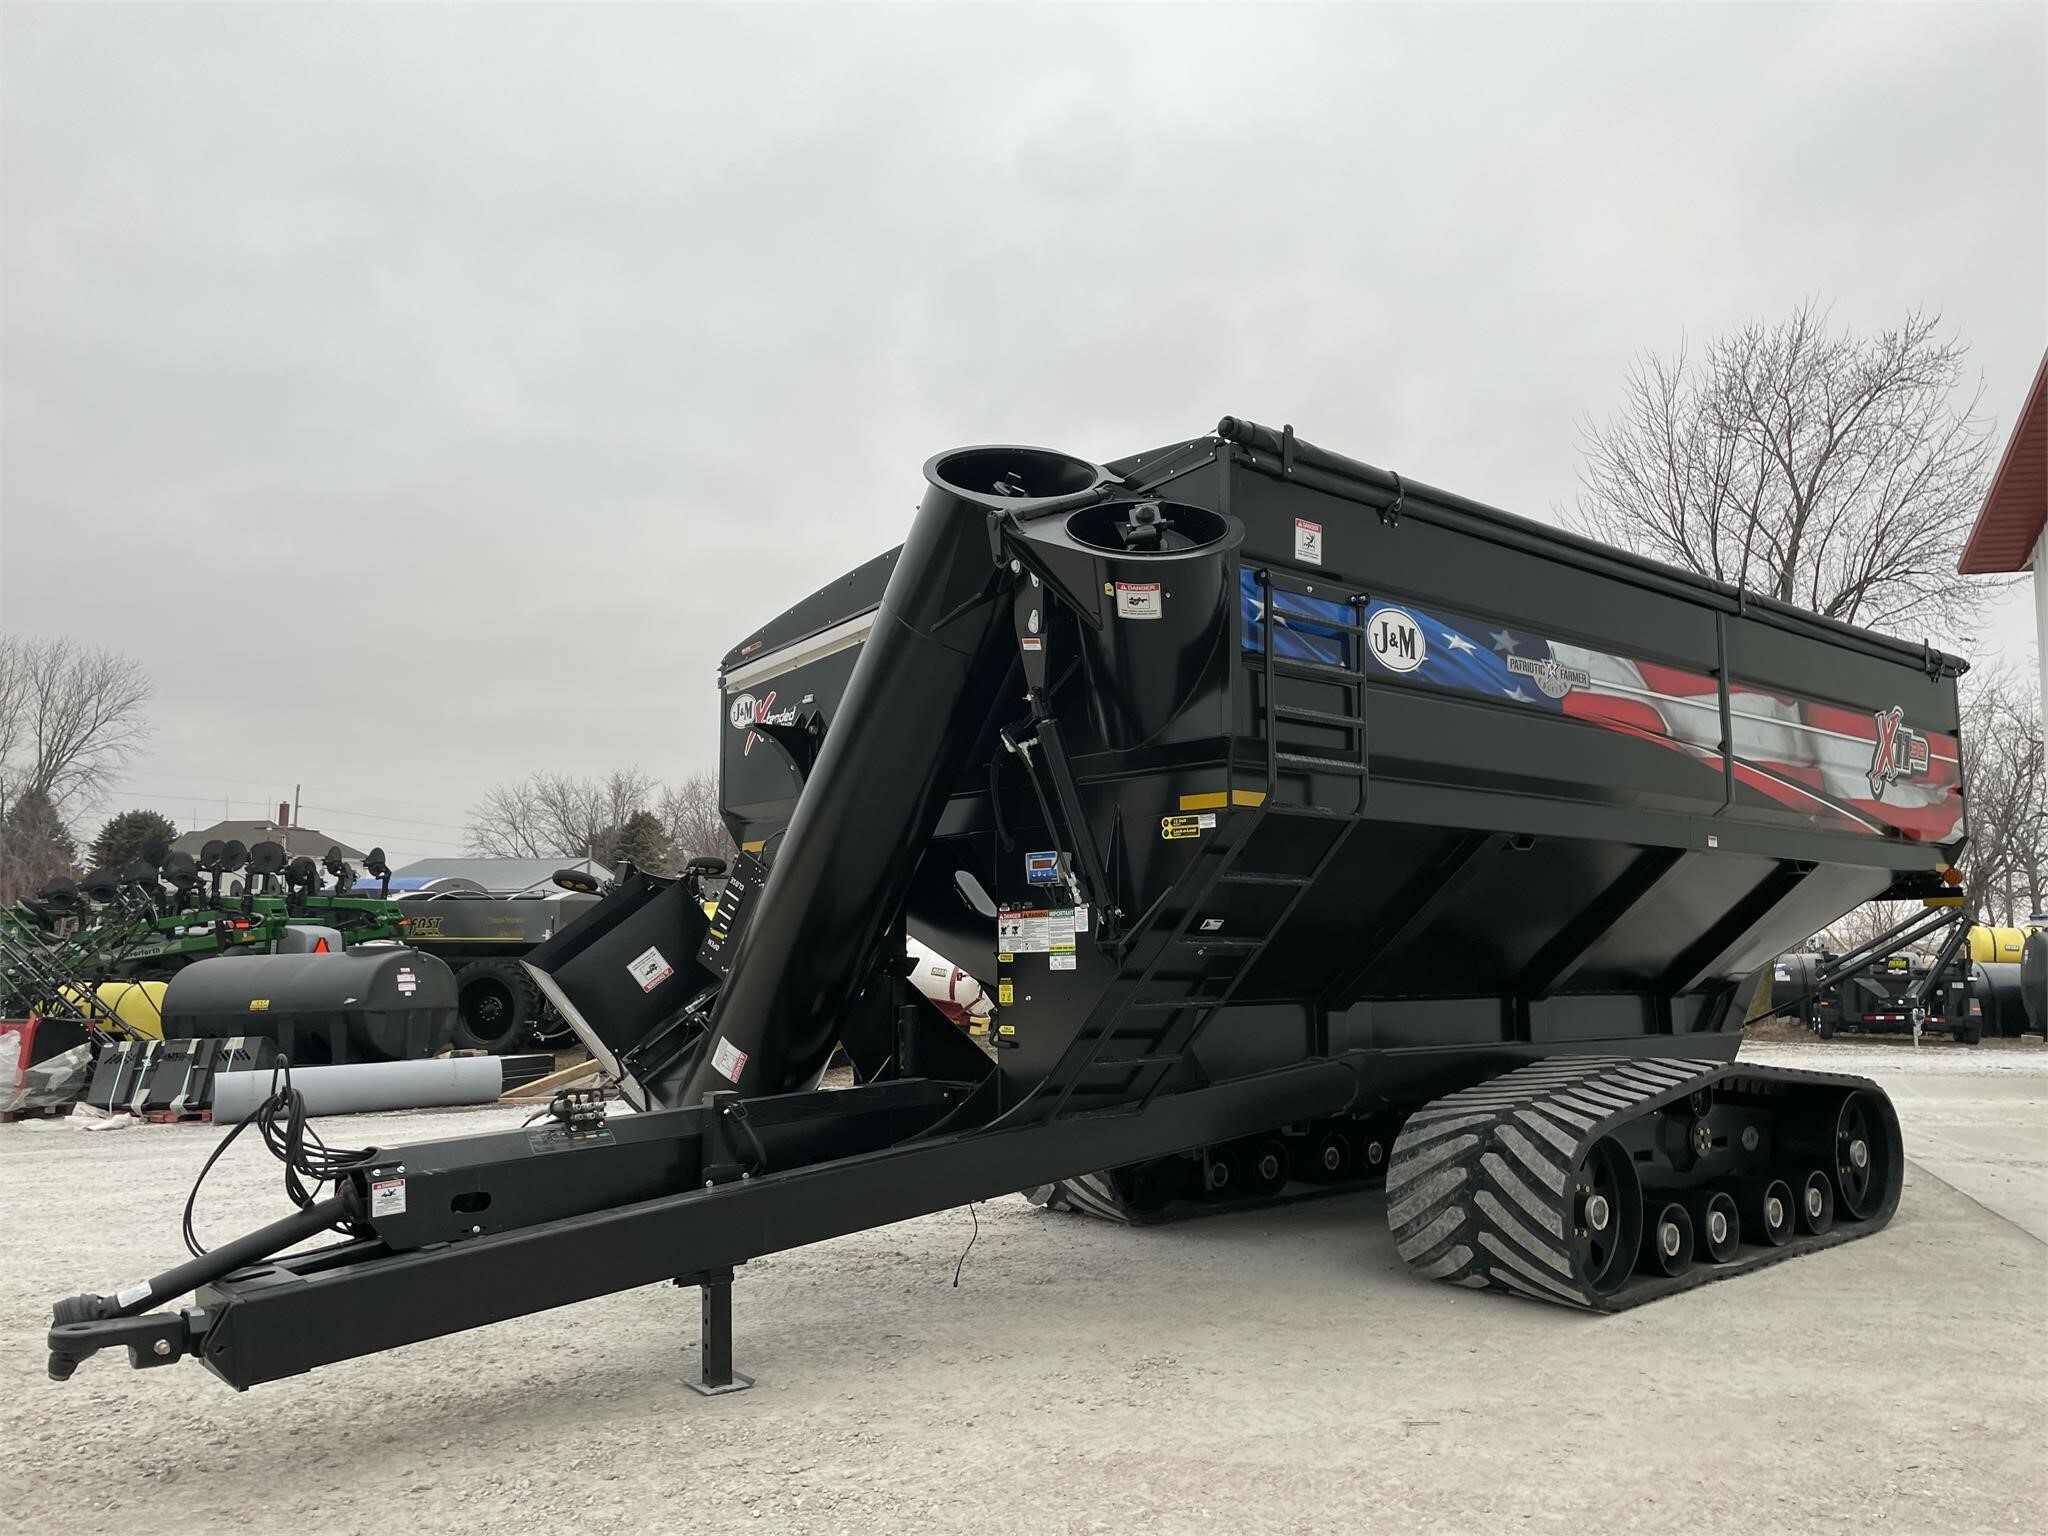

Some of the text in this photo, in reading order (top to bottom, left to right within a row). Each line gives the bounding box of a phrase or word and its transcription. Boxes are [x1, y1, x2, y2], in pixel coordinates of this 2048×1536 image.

[1373, 621, 1417, 660] J&M
[1509, 658, 1588, 685] PATRIOTIC FARMER
[733, 701, 754, 722] J&M
[729, 876, 746, 892] CLOSE
[1049, 909, 1074, 917] IMPORTANT
[707, 939, 720, 951] OPEN
